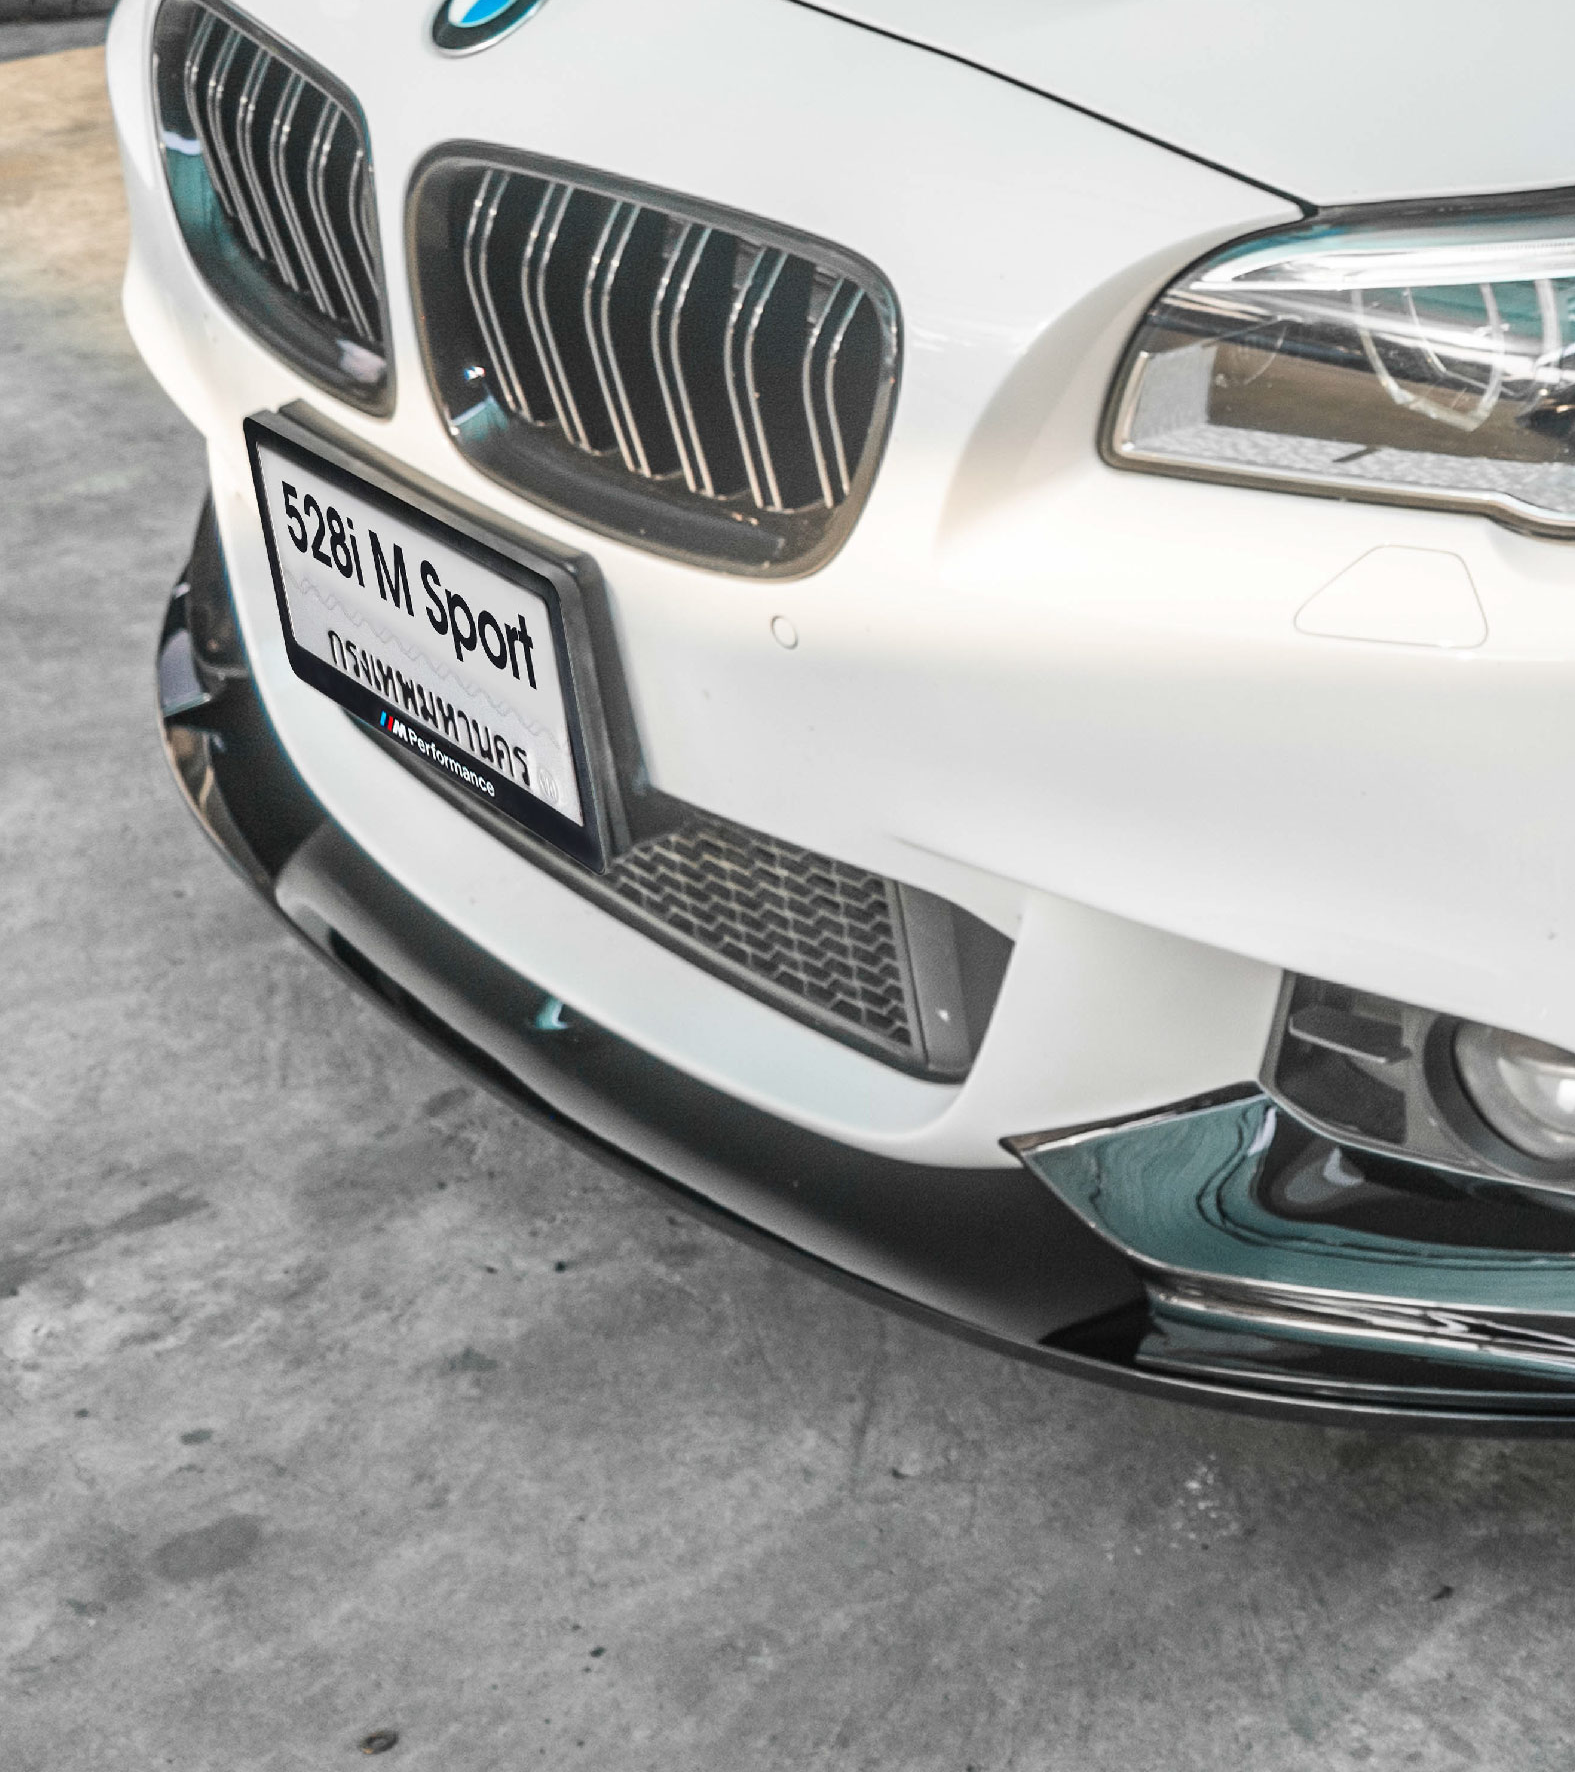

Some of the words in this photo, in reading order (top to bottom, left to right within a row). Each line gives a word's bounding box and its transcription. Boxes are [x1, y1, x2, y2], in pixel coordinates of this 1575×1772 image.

[281, 481, 365, 588] 528i
[368, 529, 415, 617] M
[420, 559, 537, 691] Sport
[327, 630, 531, 787] กรงเทพมหานคร
